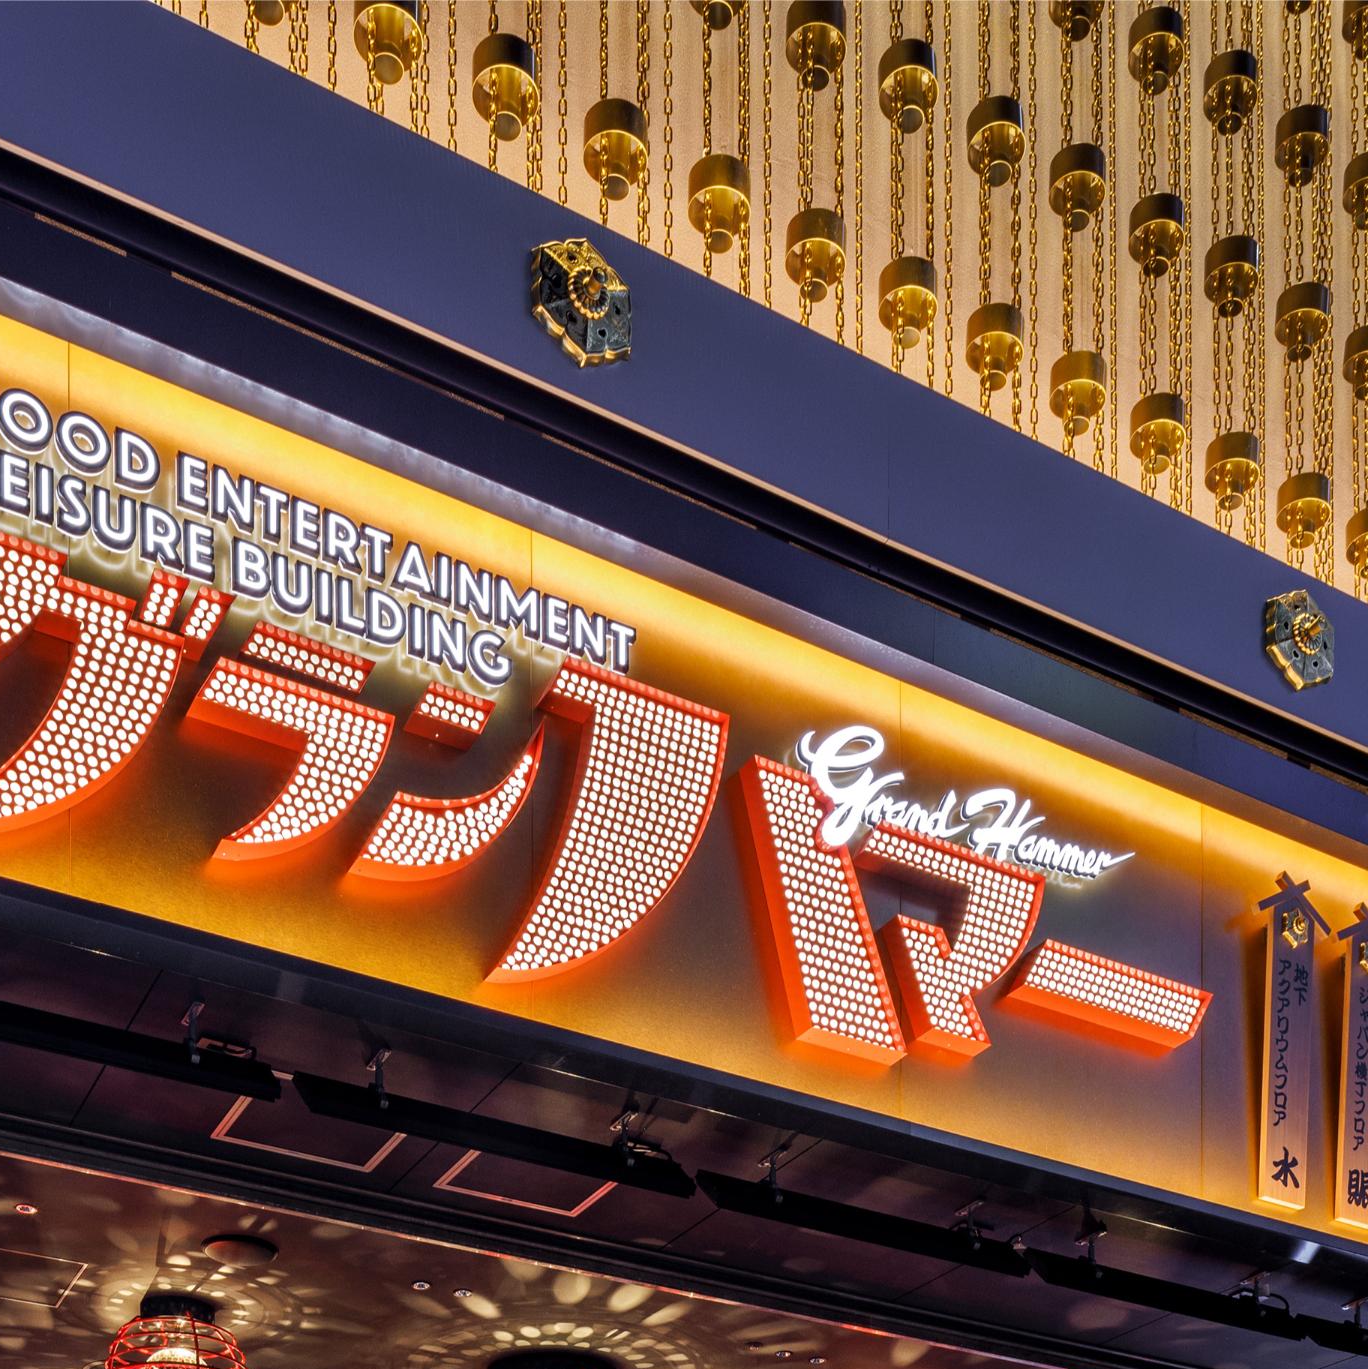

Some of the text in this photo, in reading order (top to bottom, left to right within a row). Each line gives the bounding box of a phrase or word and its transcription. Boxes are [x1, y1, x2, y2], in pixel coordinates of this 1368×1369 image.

[176, 449, 637, 676] ENTERTAINMENT
[233, 541, 514, 689] BUILDING
[795, 725, 1135, 880] Grand Hammer
[1273, 959, 1293, 1127] アクアリウムフロア
[1294, 963, 1309, 1006] 地下
[1272, 1147, 1301, 1189] 水
